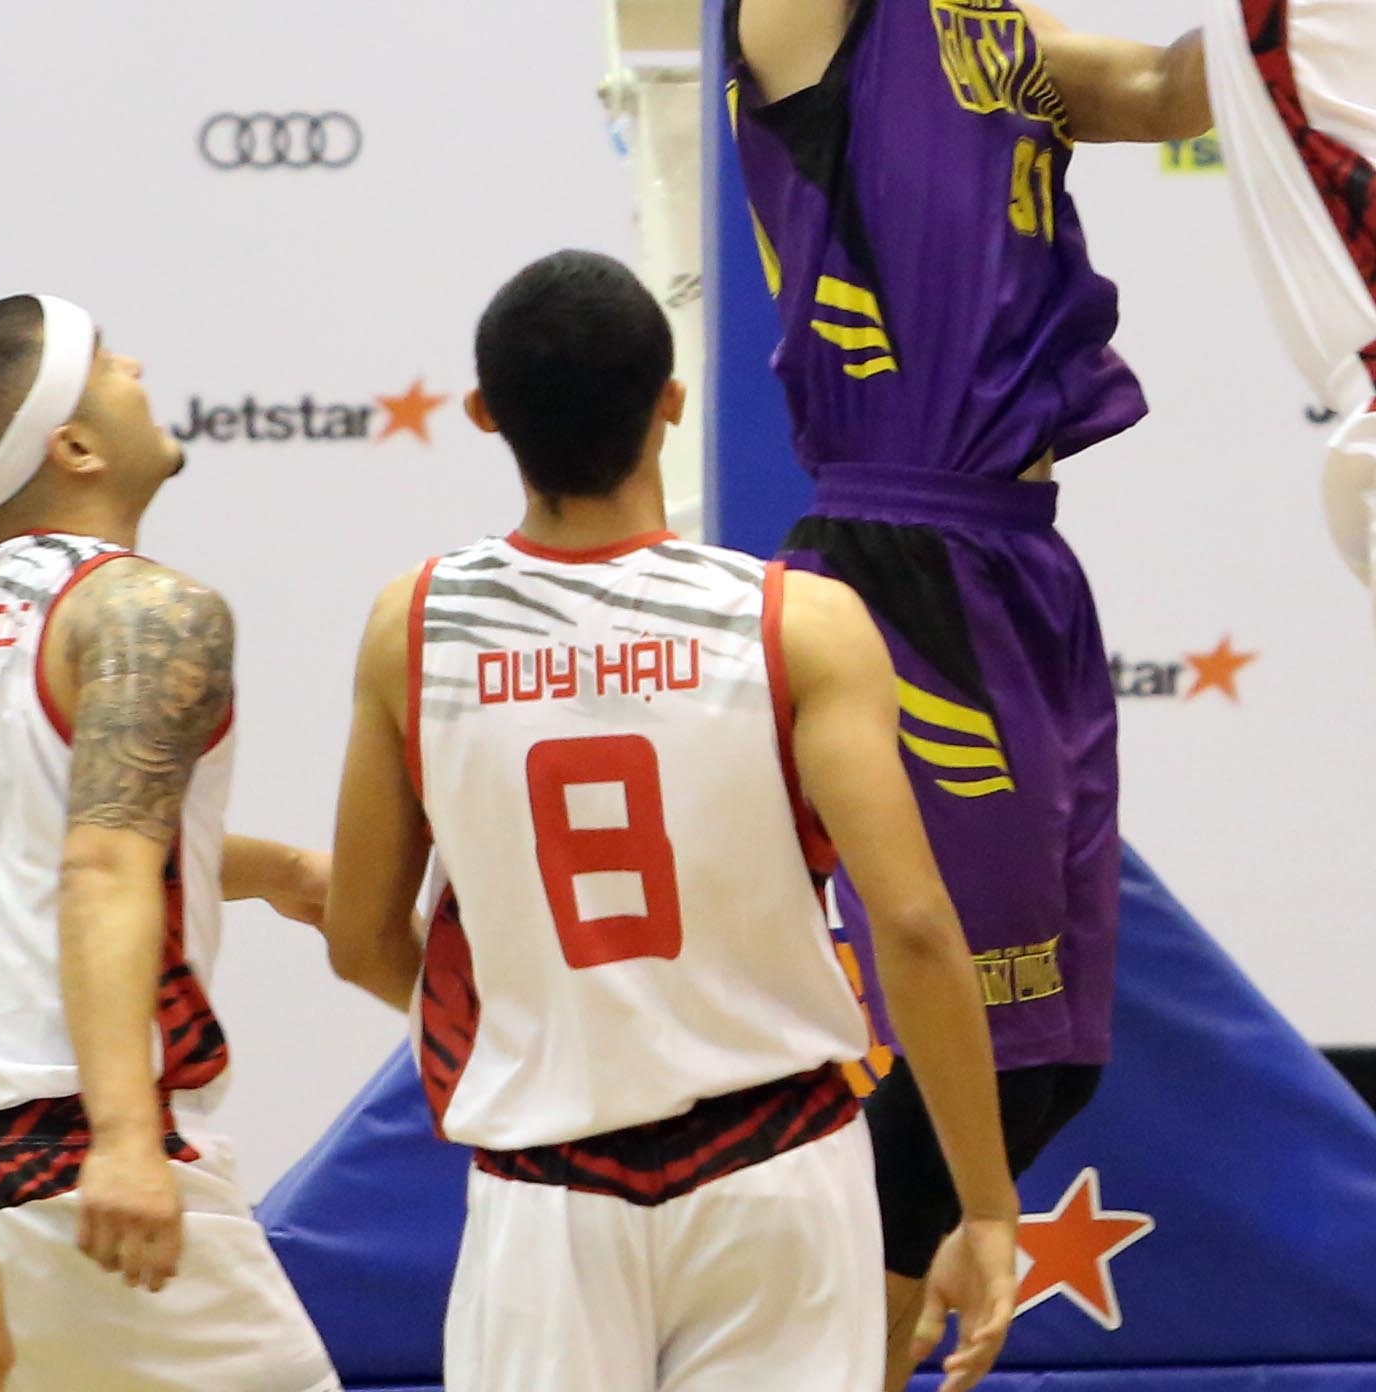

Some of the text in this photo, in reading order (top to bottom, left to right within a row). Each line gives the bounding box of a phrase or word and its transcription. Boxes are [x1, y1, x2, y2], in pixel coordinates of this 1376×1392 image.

[170, 393, 372, 442] Jetstar
[477, 630, 700, 704] DUY HẬU
[526, 733, 683, 970] 8
